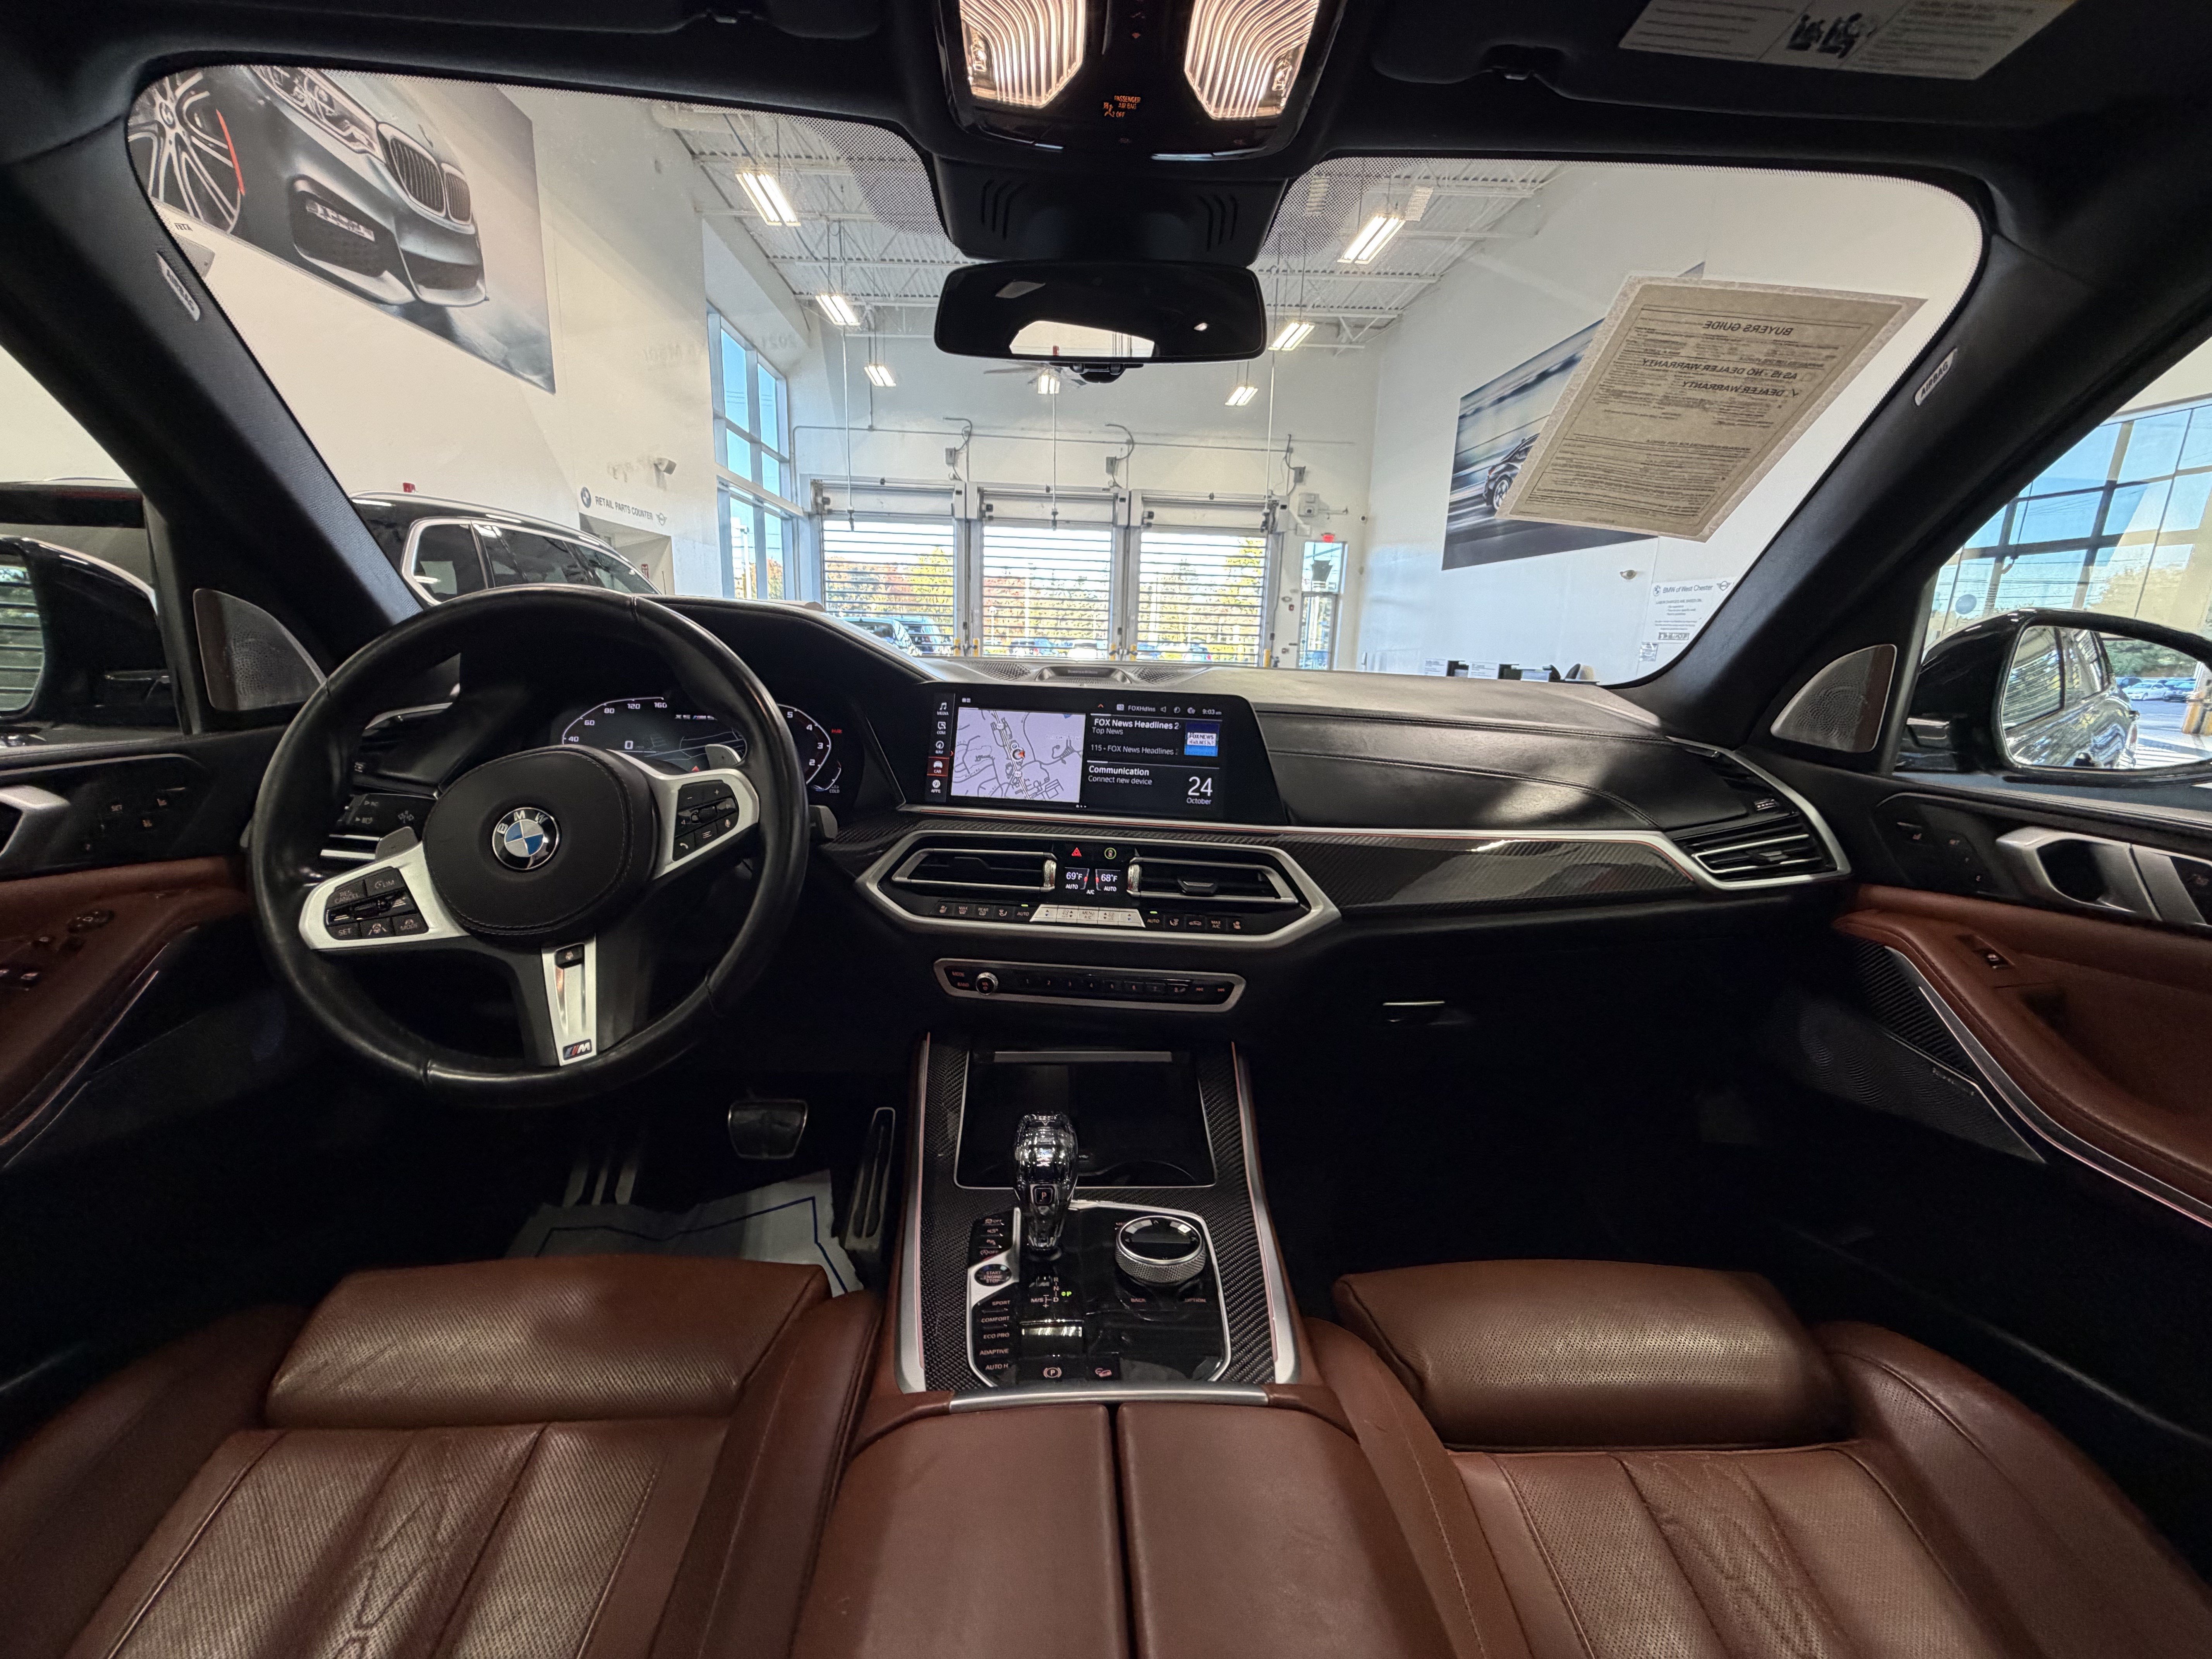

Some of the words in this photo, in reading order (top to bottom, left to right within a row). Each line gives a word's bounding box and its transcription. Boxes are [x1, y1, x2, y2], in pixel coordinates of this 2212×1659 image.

[1114, 95, 1141, 103] PASSENGER
[595, 496, 614, 509] RETAIL
[615, 501, 631, 514] PARTS
[632, 507, 653, 520] COUNTER
[1112, 719, 1133, 728] News
[1134, 721, 1173, 730] Headlines
[1092, 727, 1104, 735] Top
[624, 740, 634, 750] 0
[1123, 745, 1140, 754] News
[1089, 765, 1149, 776] Communication
[1088, 775, 1115, 783] Connect
[1131, 777, 1152, 785] device
[1188, 776, 1213, 797] 24
[1186, 797, 1212, 805] October
[496, 810, 549, 835] BMW
[338, 928, 351, 936] SET
[1042, 1192, 1047, 1200] P
